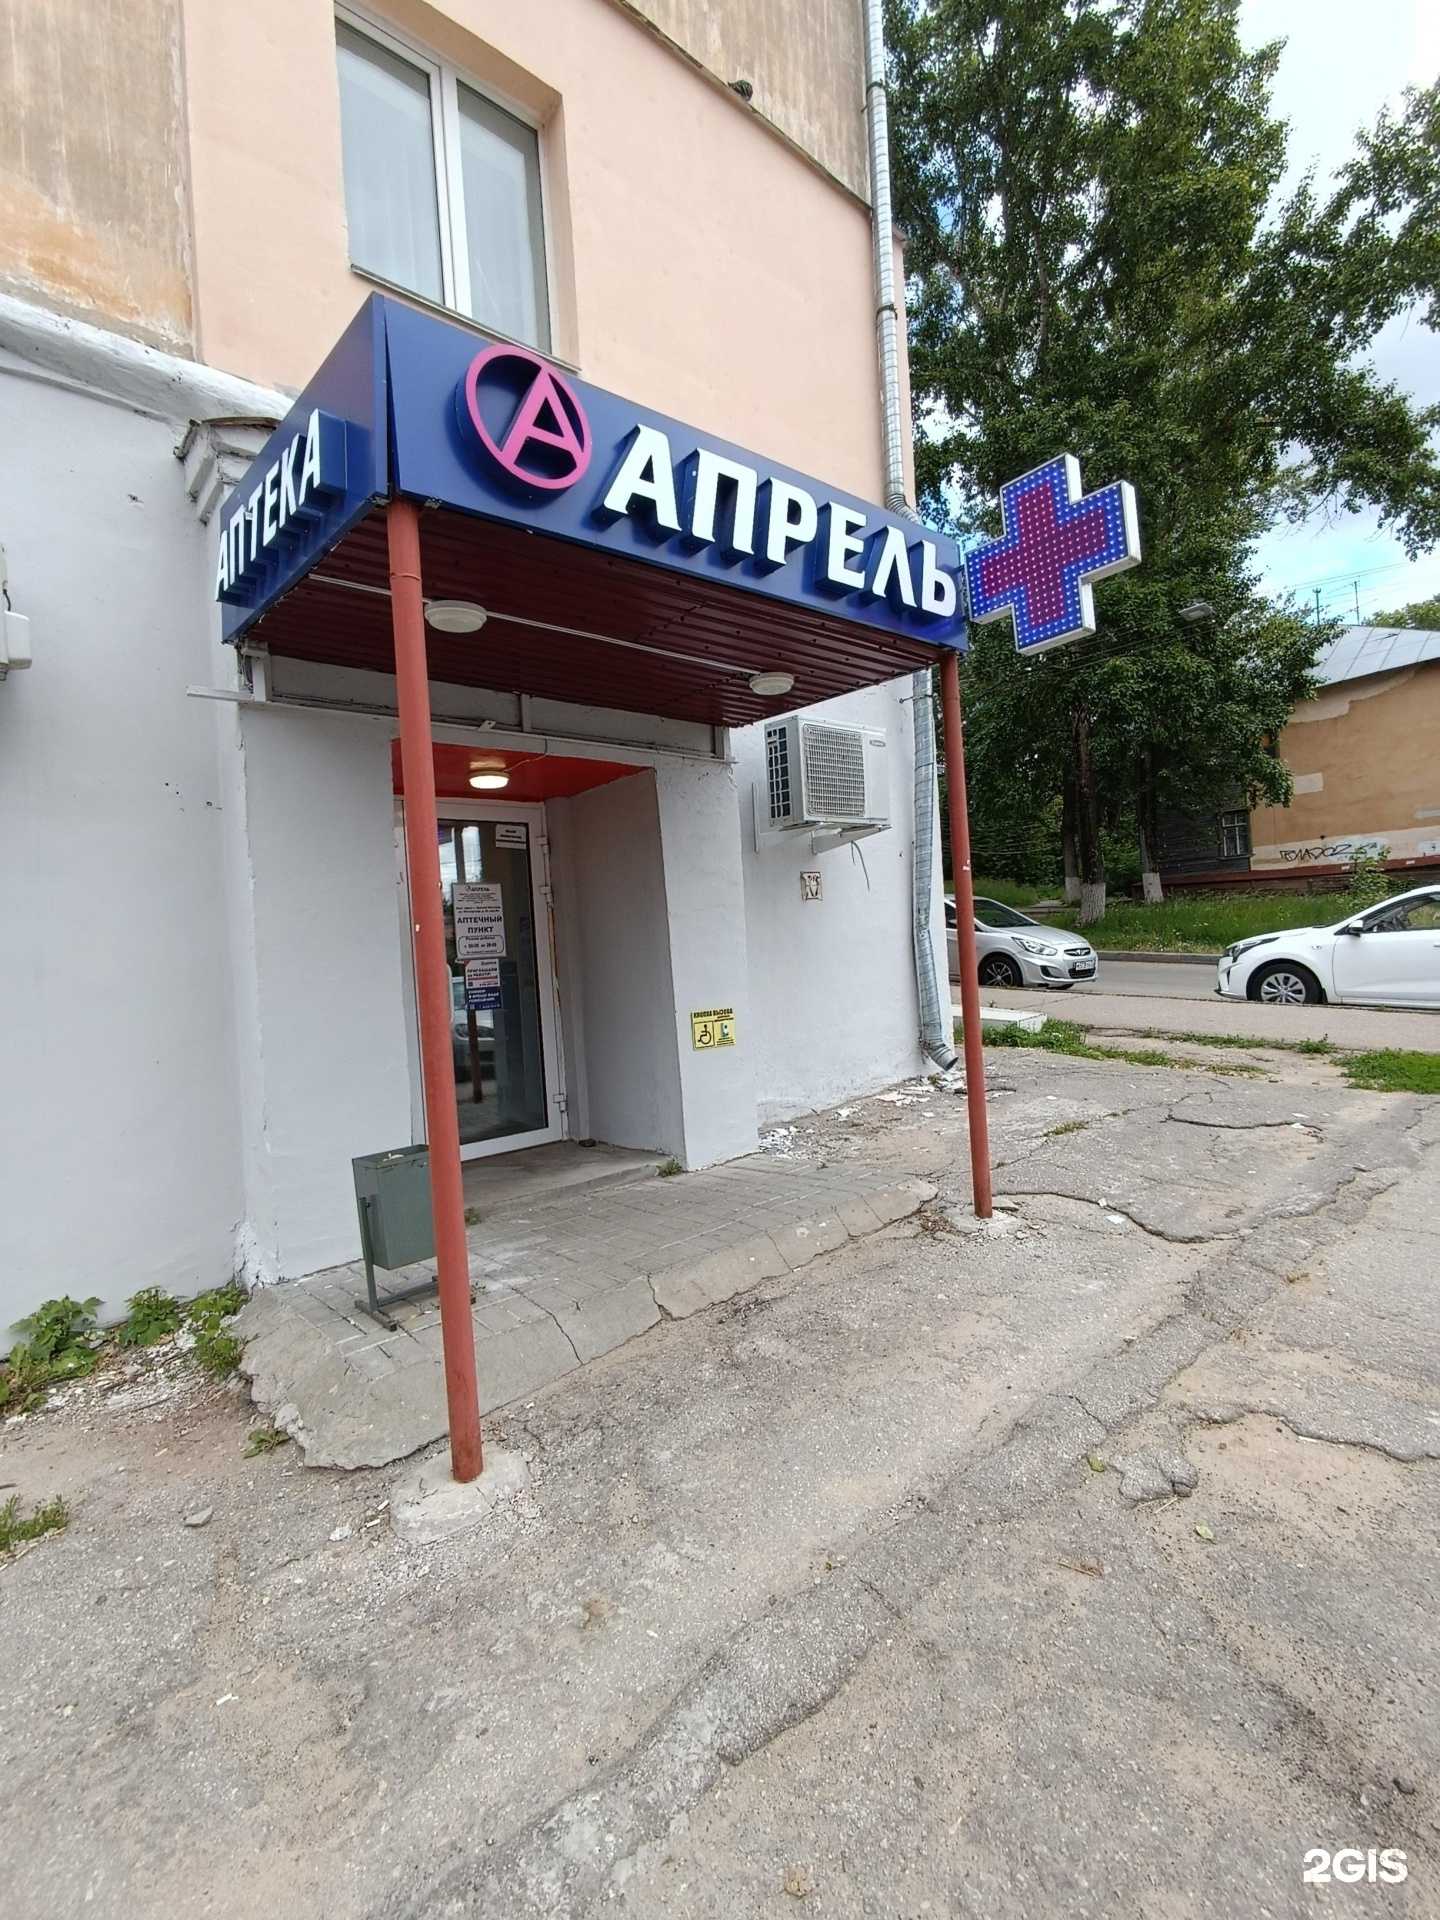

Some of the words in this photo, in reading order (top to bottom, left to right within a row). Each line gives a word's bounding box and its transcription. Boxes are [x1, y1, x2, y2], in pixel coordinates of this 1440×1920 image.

[216, 408, 322, 601] АПТЕКА
[604, 424, 956, 617] АПРЕЛЬ
[457, 915, 502, 924] АПТЕЧНЫЙ
[467, 926, 494, 934] ПУНКТ
